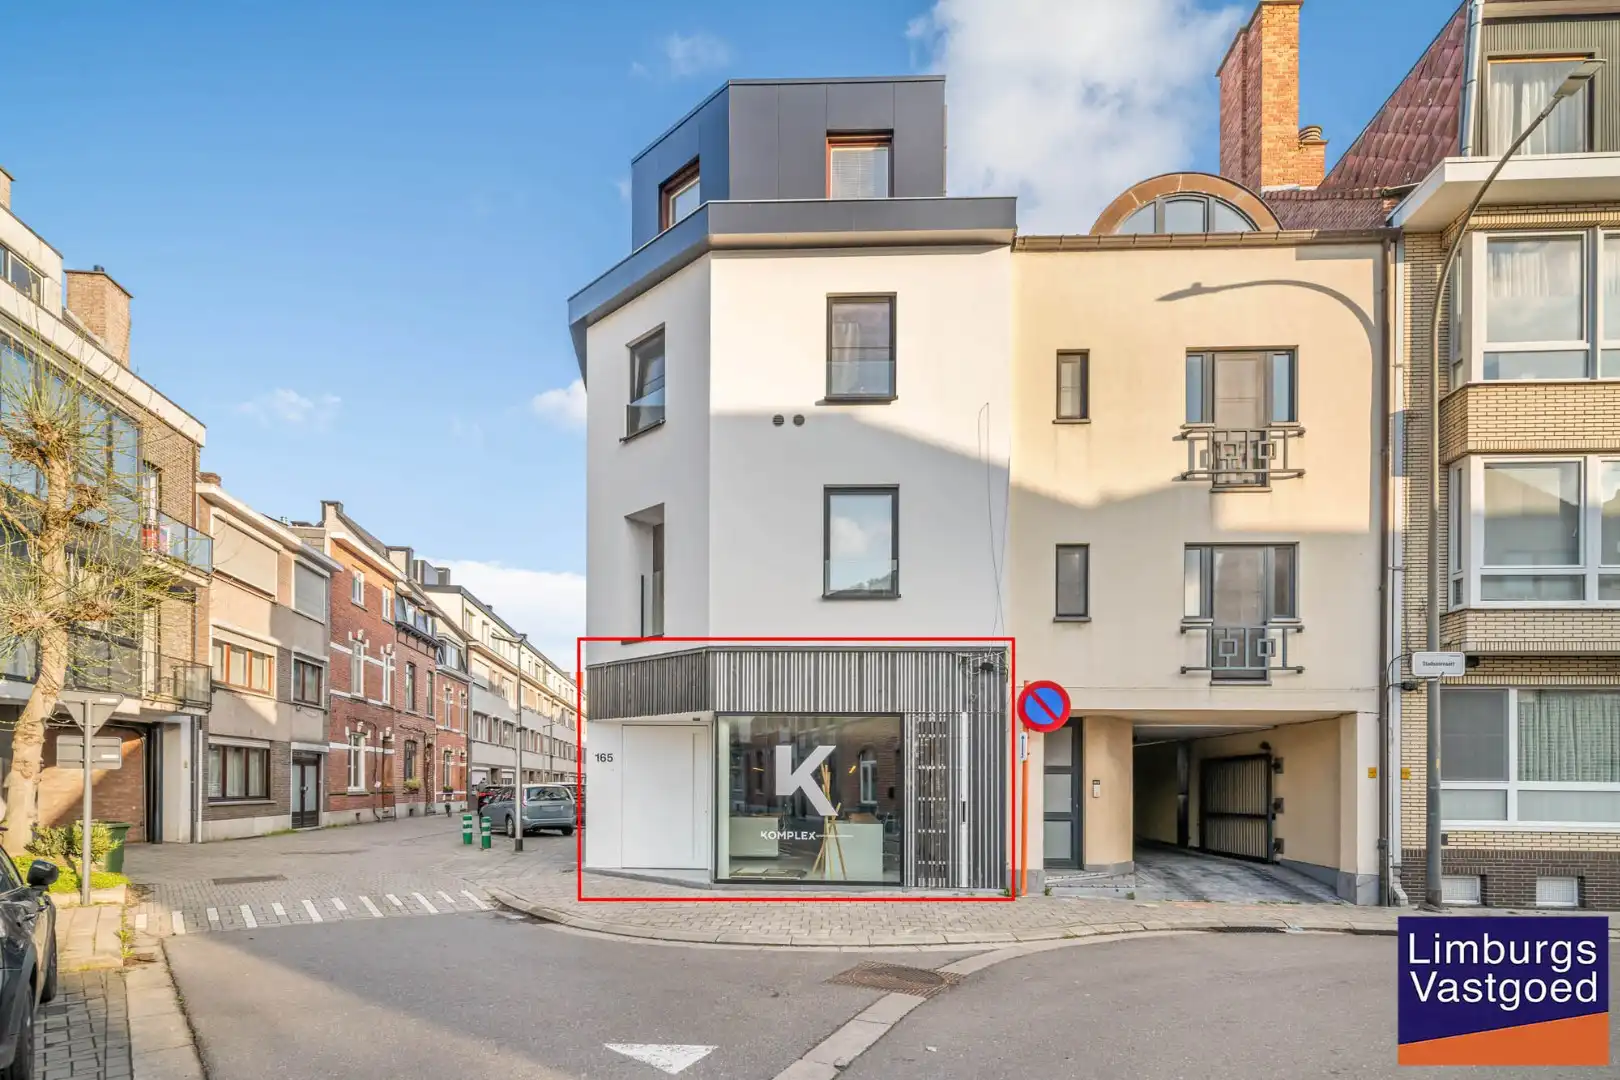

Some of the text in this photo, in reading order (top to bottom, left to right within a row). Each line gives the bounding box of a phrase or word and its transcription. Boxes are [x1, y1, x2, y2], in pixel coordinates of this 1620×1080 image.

[595, 753, 613, 763] 165
[776, 745, 838, 816] K
[760, 831, 816, 840] KOMPLEX
